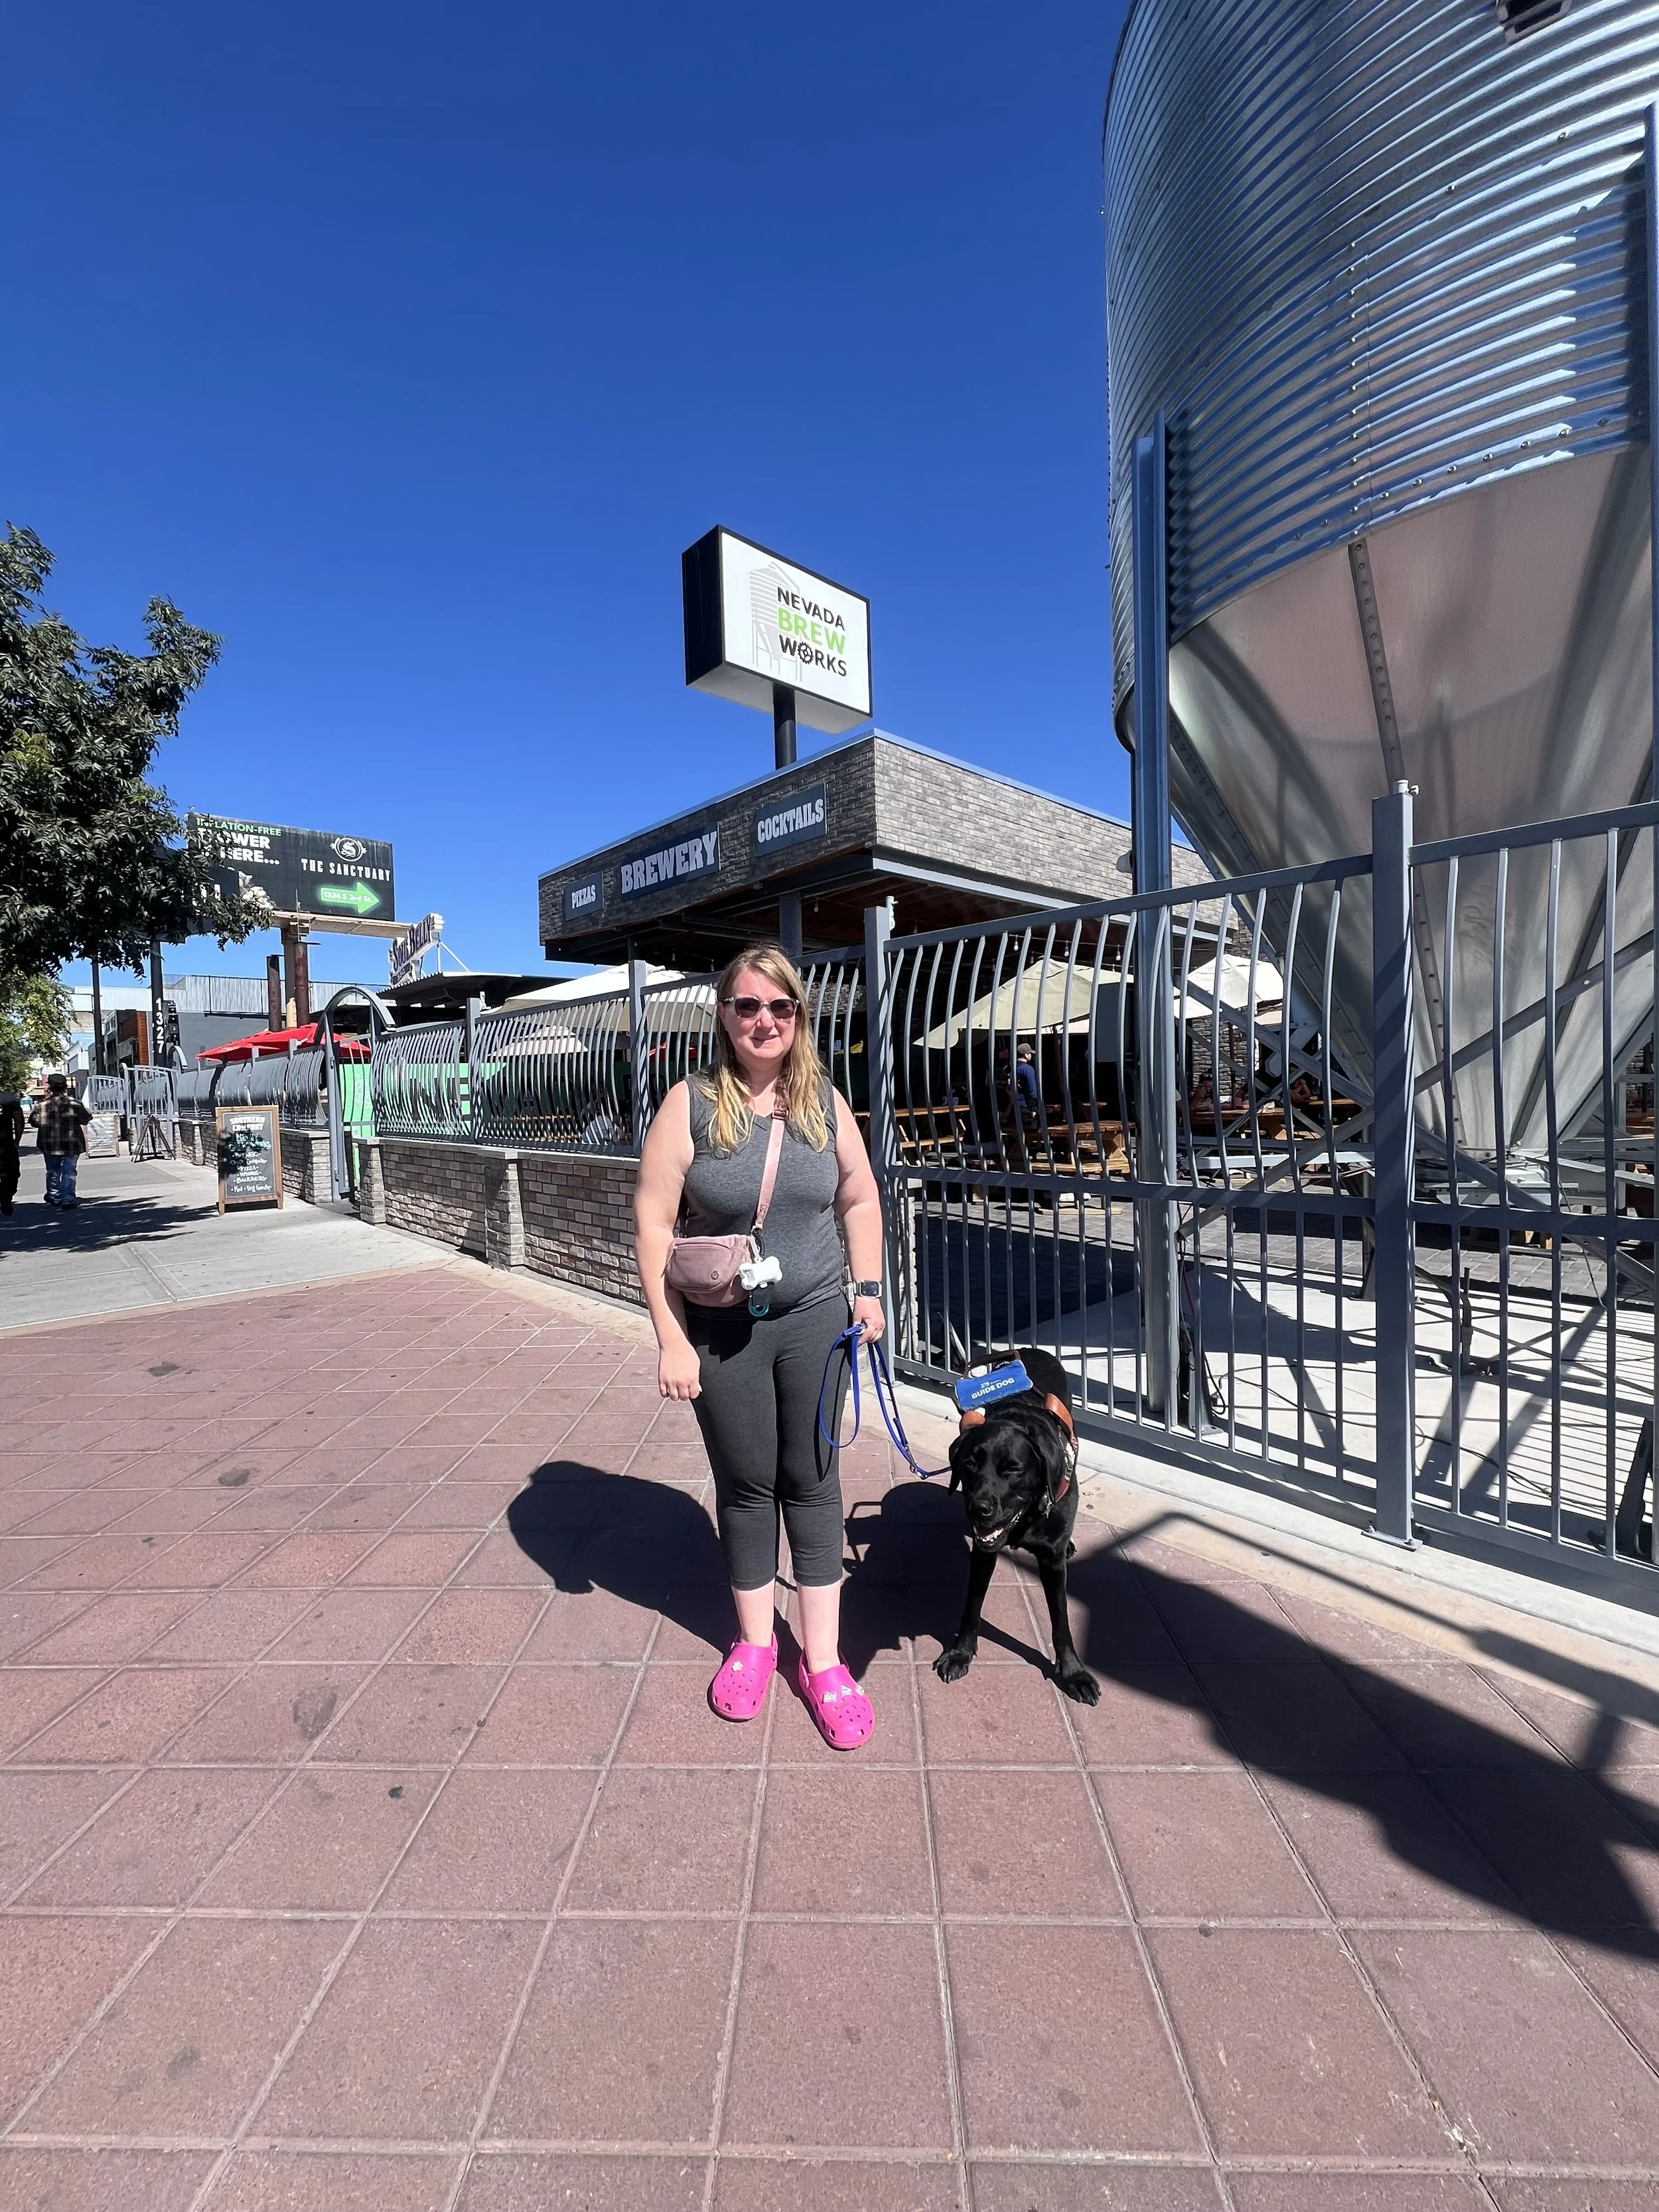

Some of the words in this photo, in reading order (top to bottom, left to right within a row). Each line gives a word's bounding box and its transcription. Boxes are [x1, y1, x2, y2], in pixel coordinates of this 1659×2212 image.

[777, 586, 845, 632] NEVADA
[777, 607, 846, 655] BREW
[779, 634, 847, 677] WORKS
[757, 798, 824, 844] COCKTAILS
[301, 858, 324, 873] THE
[329, 861, 391, 881] SANCTUARY
[620, 830, 717, 895] BREWERY
[571, 884, 597, 909] PIZZAS
[155, 997, 165, 1054] 1327
[972, 1384, 996, 1399] GUIDE
[996, 1377, 1015, 1389] DOG
